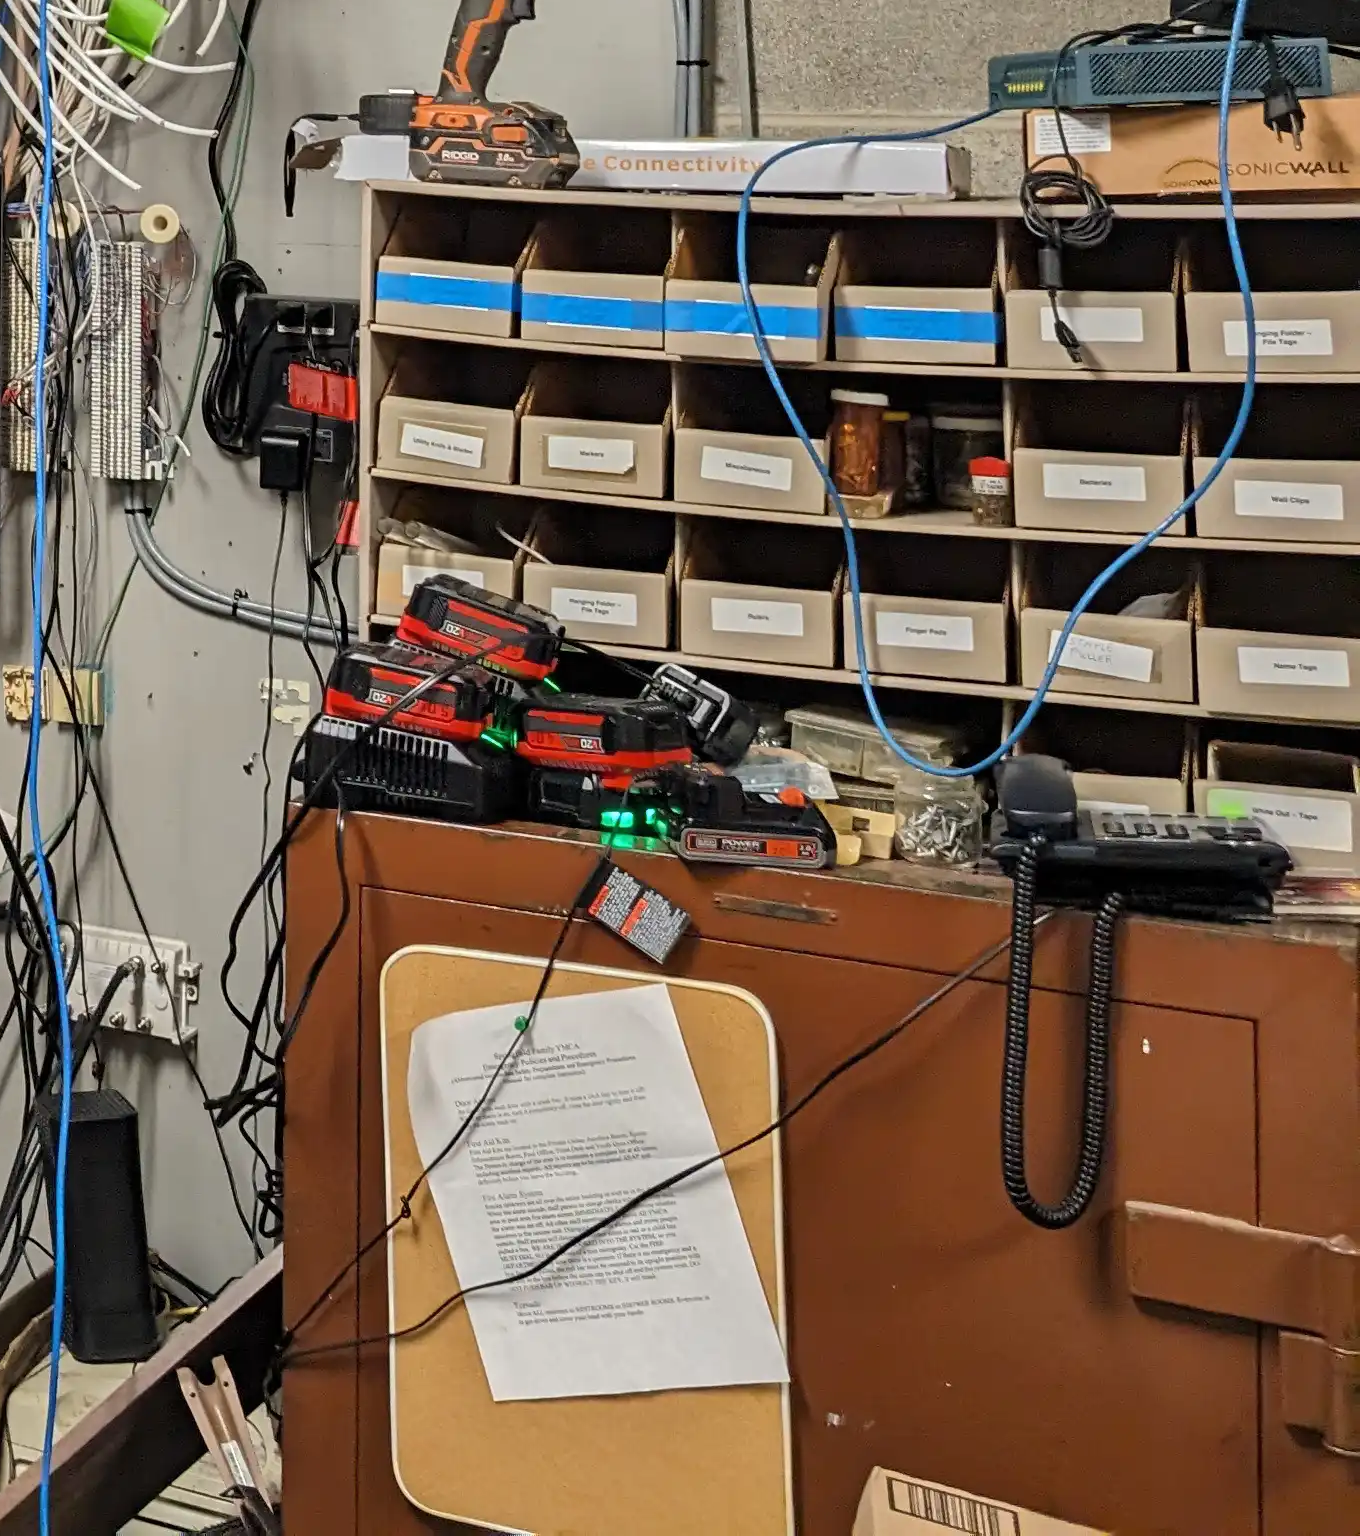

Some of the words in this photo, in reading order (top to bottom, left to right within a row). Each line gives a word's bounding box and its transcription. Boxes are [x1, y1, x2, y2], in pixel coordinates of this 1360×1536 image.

[603, 155, 763, 173] Connectivity
[1226, 161, 1351, 178] SONICWALL
[1162, 177, 1220, 189] SONICWAL
[721, 837, 761, 849] POWER
[556, 1042, 581, 1053] YMCA
